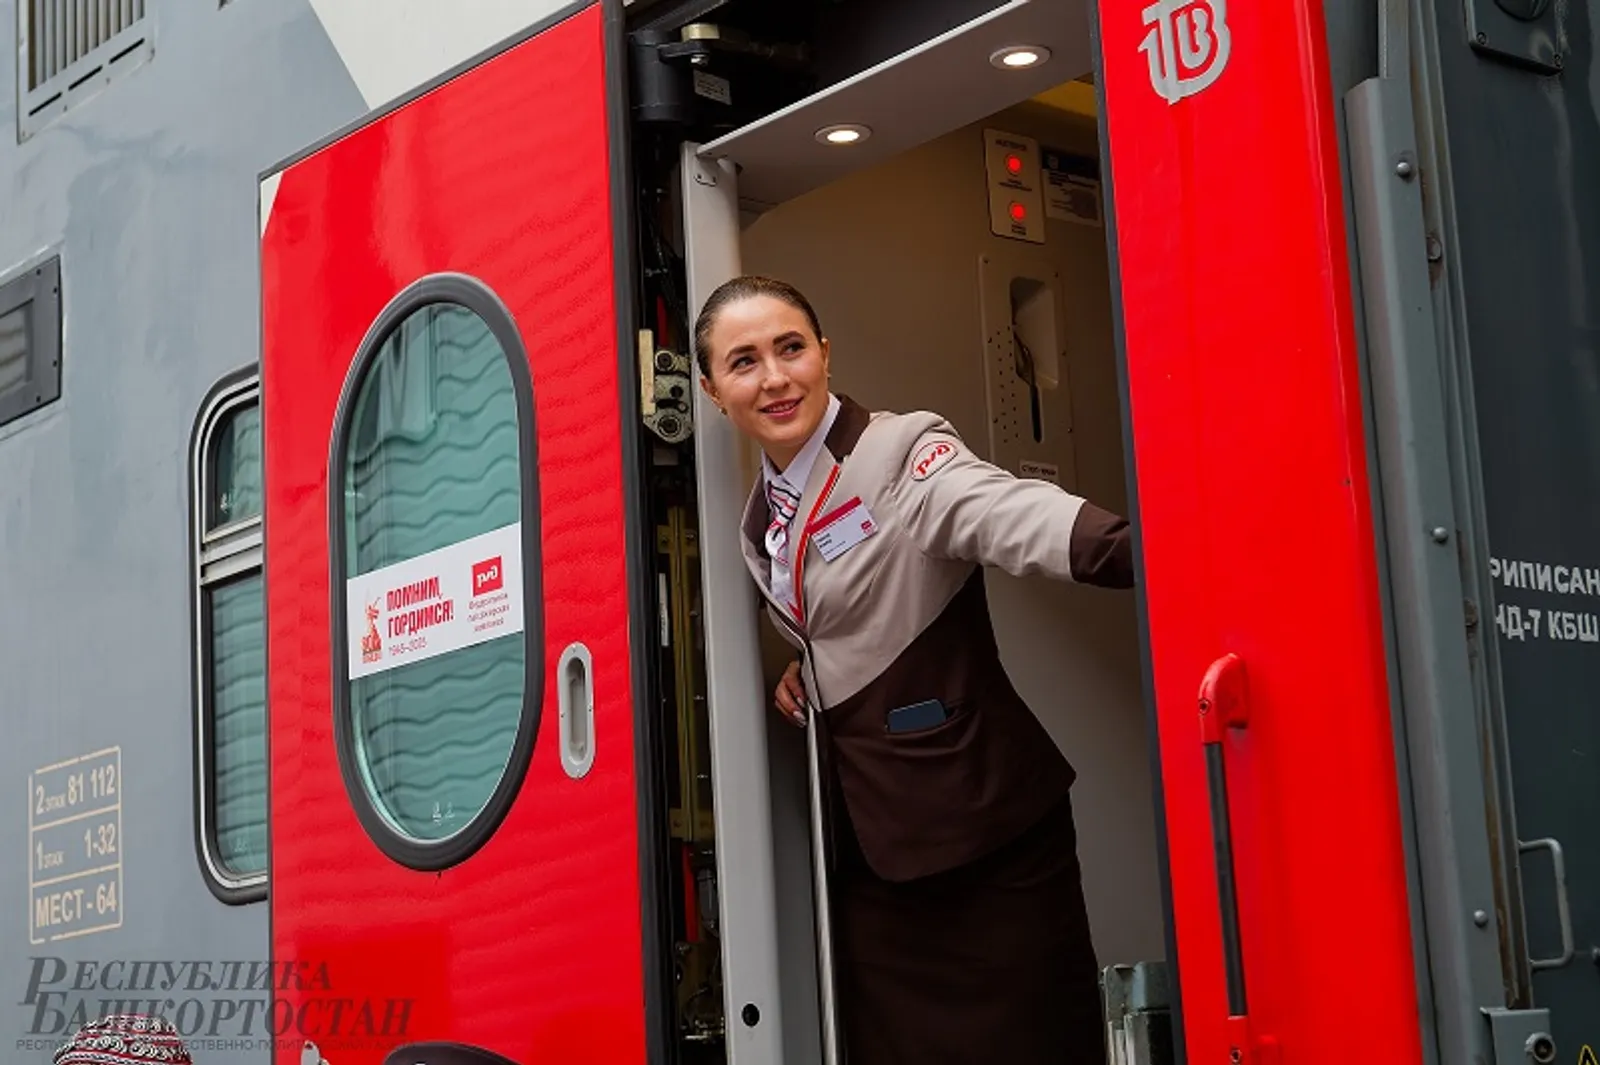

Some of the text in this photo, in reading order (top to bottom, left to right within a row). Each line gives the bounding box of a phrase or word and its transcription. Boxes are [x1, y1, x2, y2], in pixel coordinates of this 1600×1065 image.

[387, 575, 443, 612] ПОМНИМ,
[388, 598, 454, 638] ГОРДИМСЯ!
[1547, 609, 1599, 643] КБШ
[67, 772, 84, 806] 81
[90, 763, 115, 798] 112
[84, 822, 115, 858] 1-32
[36, 888, 84, 928] МЕСТ
[96, 880, 117, 914] 64
